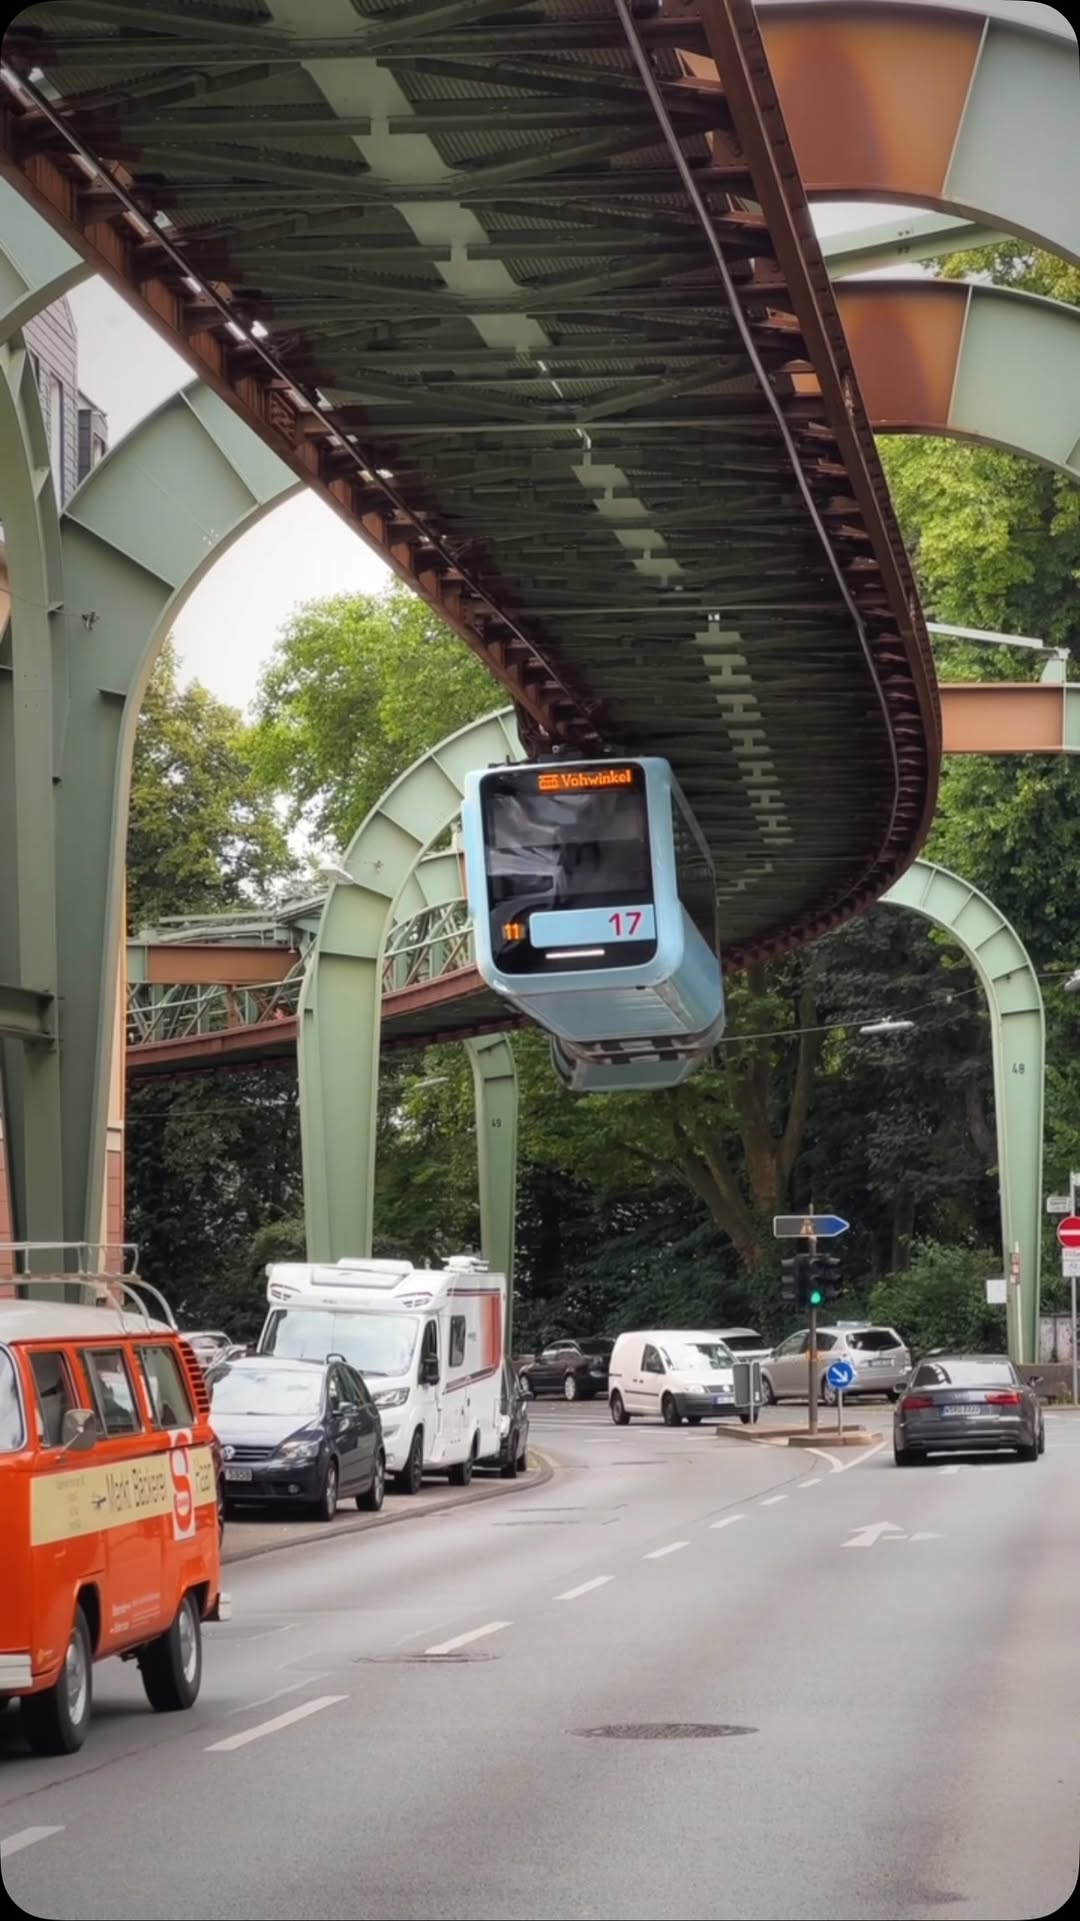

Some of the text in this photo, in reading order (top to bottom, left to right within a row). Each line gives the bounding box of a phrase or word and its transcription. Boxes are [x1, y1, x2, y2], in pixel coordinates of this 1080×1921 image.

[561, 769, 631, 787] Vohwinkel
[503, 923, 520, 941] 11
[608, 911, 642, 937] 17
